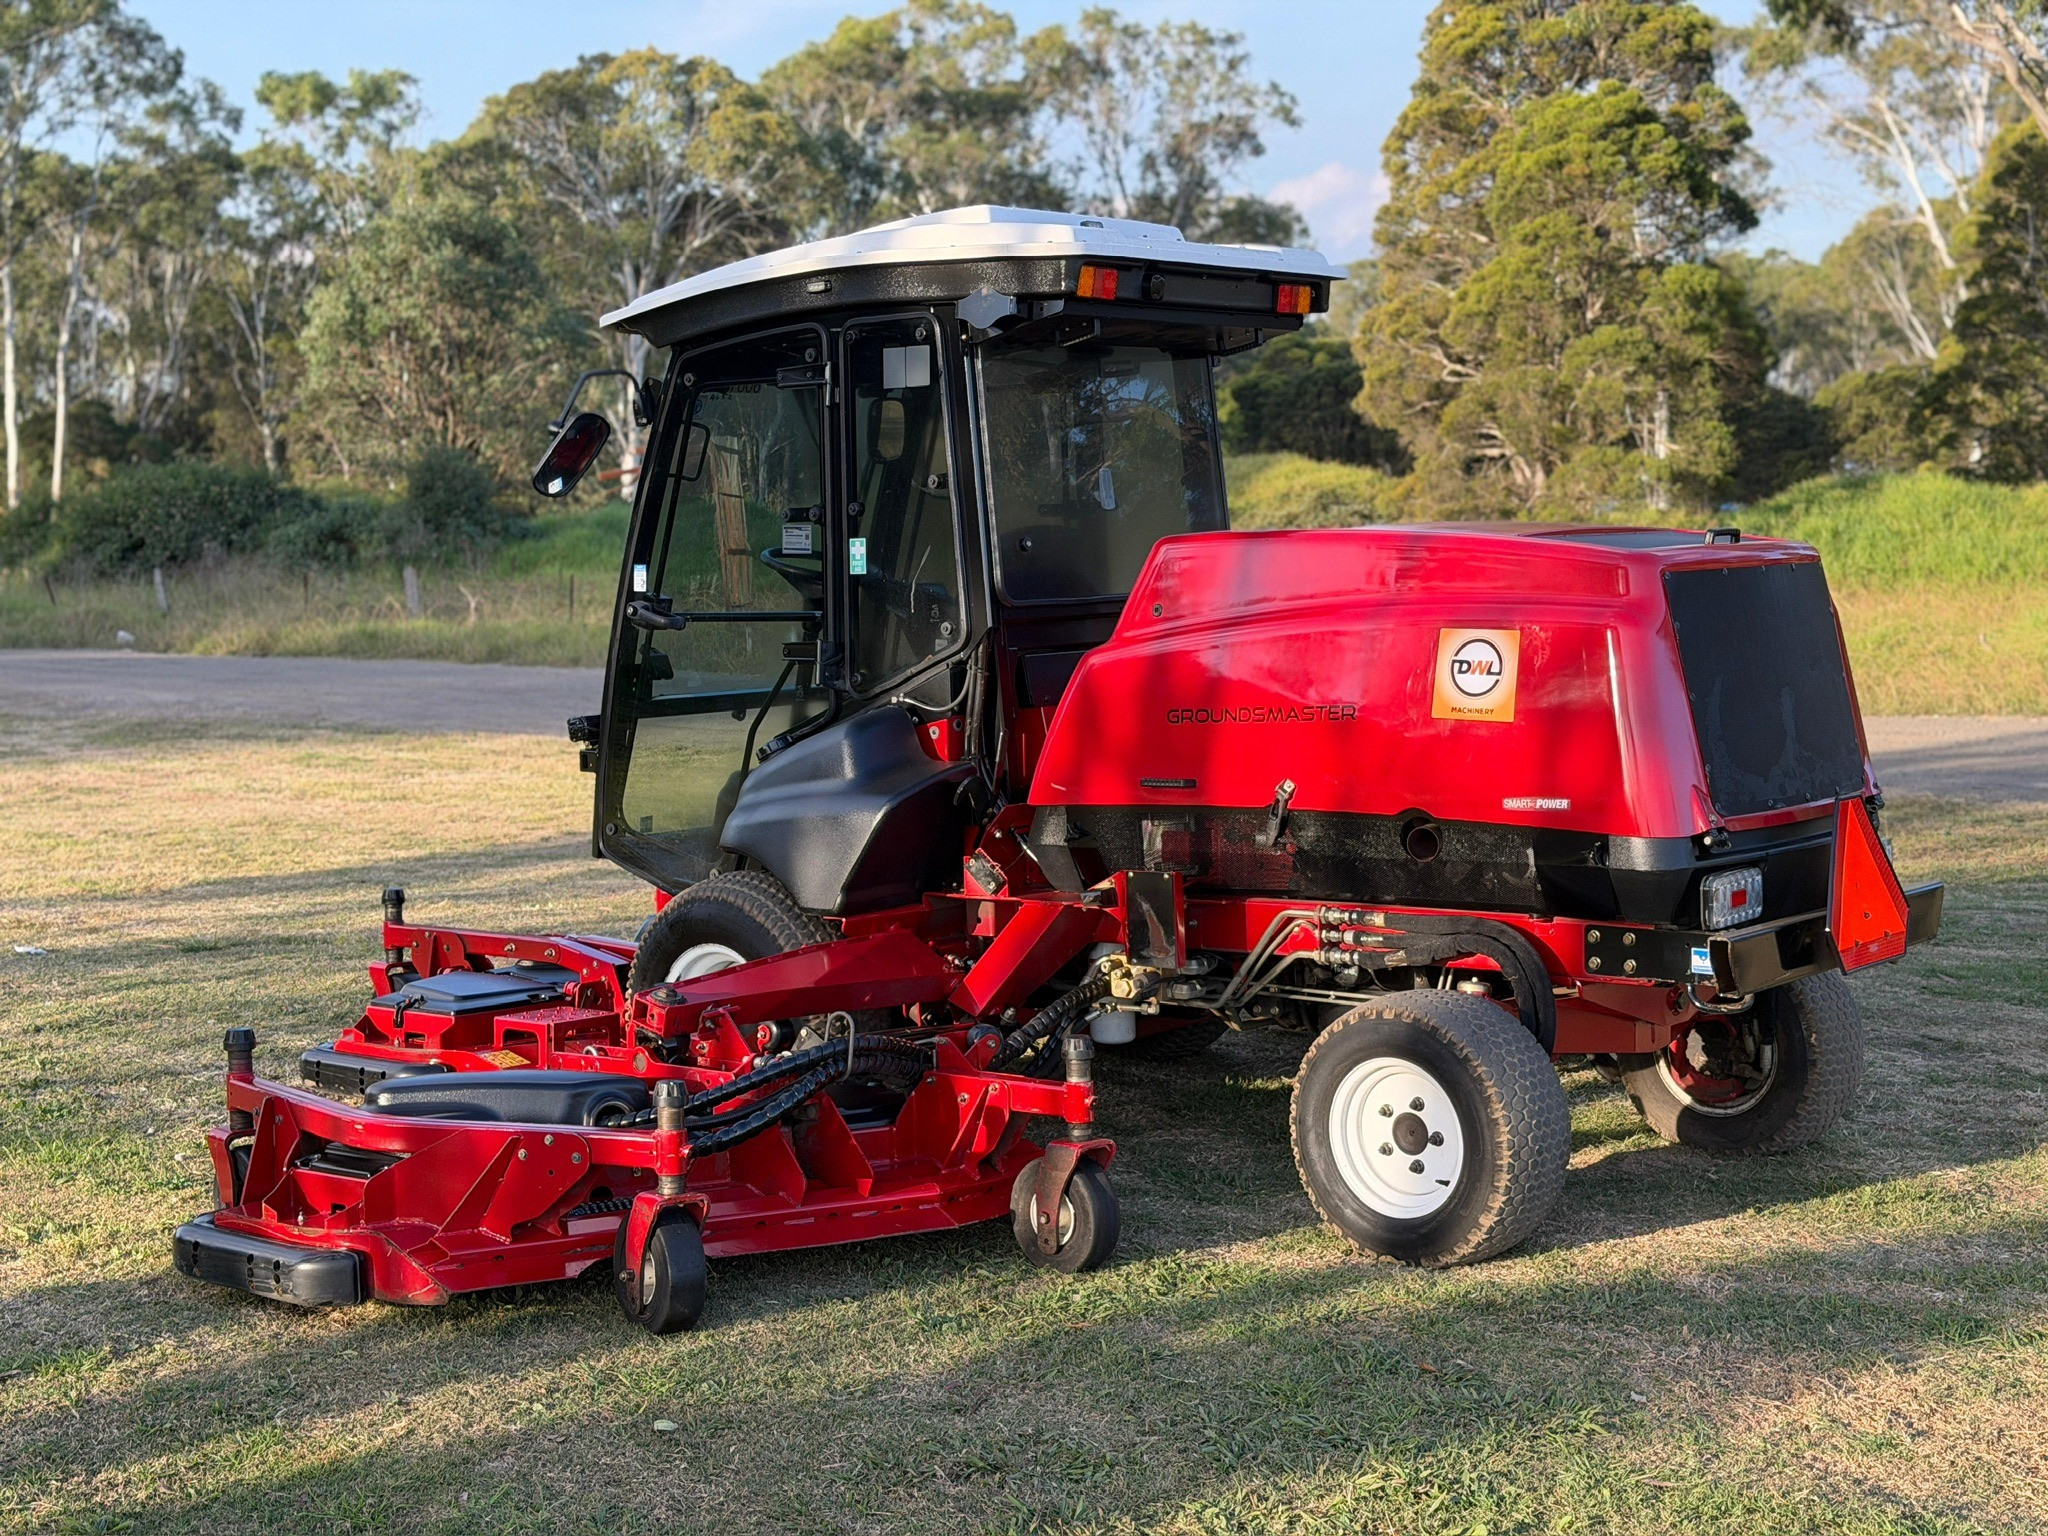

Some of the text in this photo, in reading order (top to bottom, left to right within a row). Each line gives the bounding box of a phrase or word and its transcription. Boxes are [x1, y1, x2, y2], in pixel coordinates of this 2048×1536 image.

[1452, 659, 1502, 676] DWL
[1167, 705, 1357, 724] GROUNDSMASTER
[1450, 706, 1495, 715] MACHINERY
[1503, 798, 1569, 809] SMART POWER
